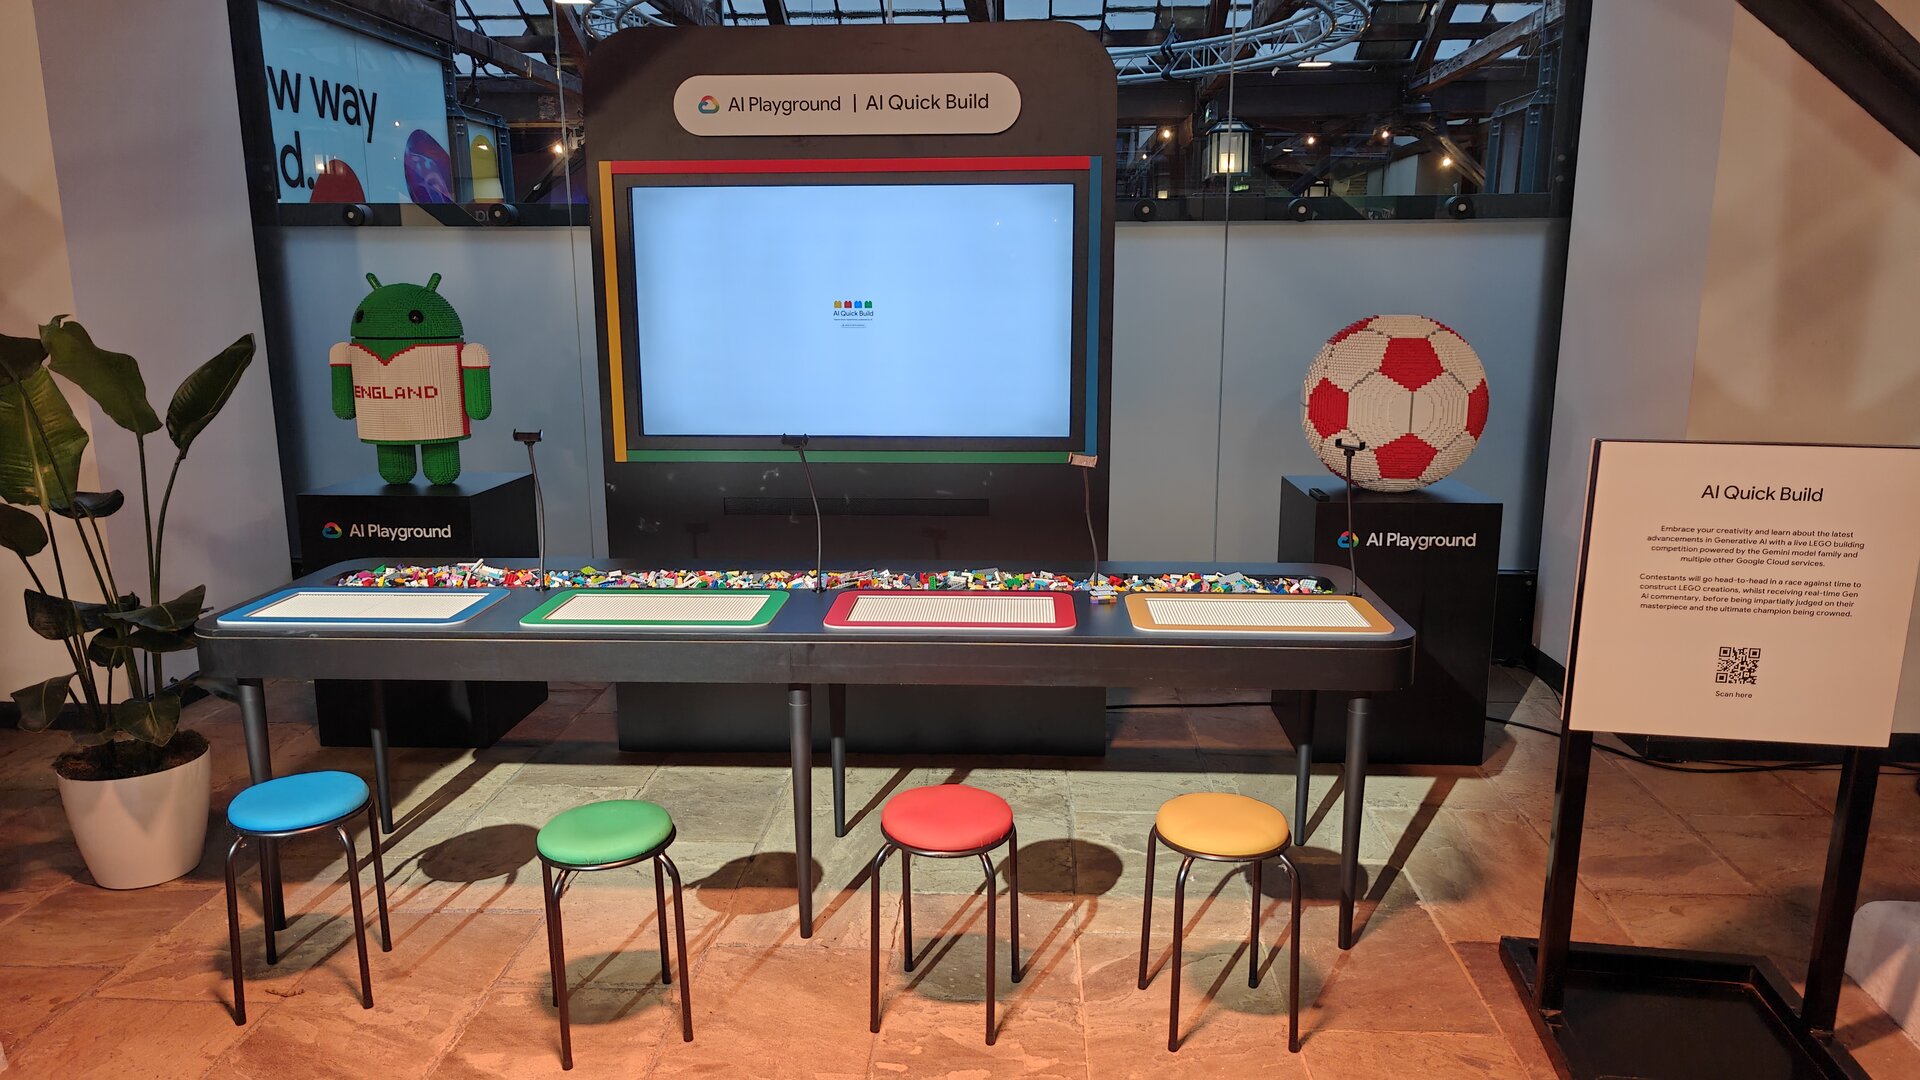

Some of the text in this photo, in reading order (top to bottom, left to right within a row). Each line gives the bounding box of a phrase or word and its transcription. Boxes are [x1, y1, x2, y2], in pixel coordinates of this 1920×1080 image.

[310, 76, 378, 144] way
[728, 97, 744, 112] AI
[749, 96, 841, 116] Playground
[866, 94, 882, 110] AI
[888, 94, 940, 110] Quick
[946, 93, 989, 110] Build
[280, 131, 314, 190] d.
[354, 385, 438, 400] ENGLAND
[1700, 484, 1824, 502] AI Quick Build
[350, 524, 452, 542] AI Playground
[1366, 532, 1476, 550] AI Playground
[1833, 541, 1865, 549] building
[1818, 550, 1841, 558] family
[1736, 558, 1764, 566] Google
[1640, 573, 1686, 582] Contestants
[1714, 576, 1768, 585] head-to-head
[1767, 588, 1803, 597] receiving
[1730, 596, 1752, 605] being
[1754, 598, 1795, 606] impartially
[1795, 599, 1823, 607] judged
[1753, 607, 1791, 615] champion
[1792, 608, 1814, 617] being
